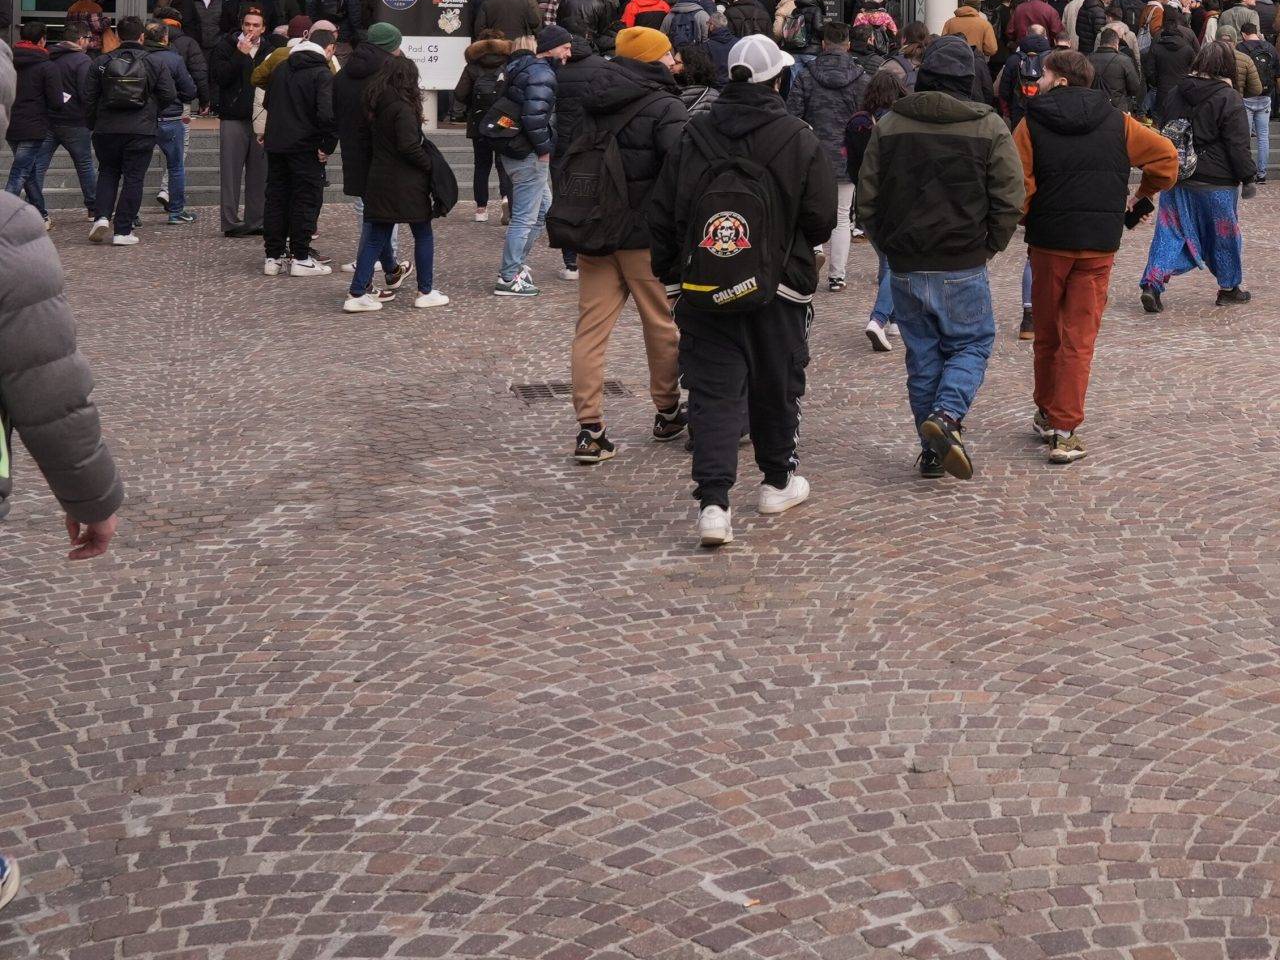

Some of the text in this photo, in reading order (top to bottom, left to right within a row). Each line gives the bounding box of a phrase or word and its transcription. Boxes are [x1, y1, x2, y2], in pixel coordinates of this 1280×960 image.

[408, 45, 439, 53] Pad. C5
[712, 288, 733, 303] CALL
[732, 276, 757, 295] DUTY
